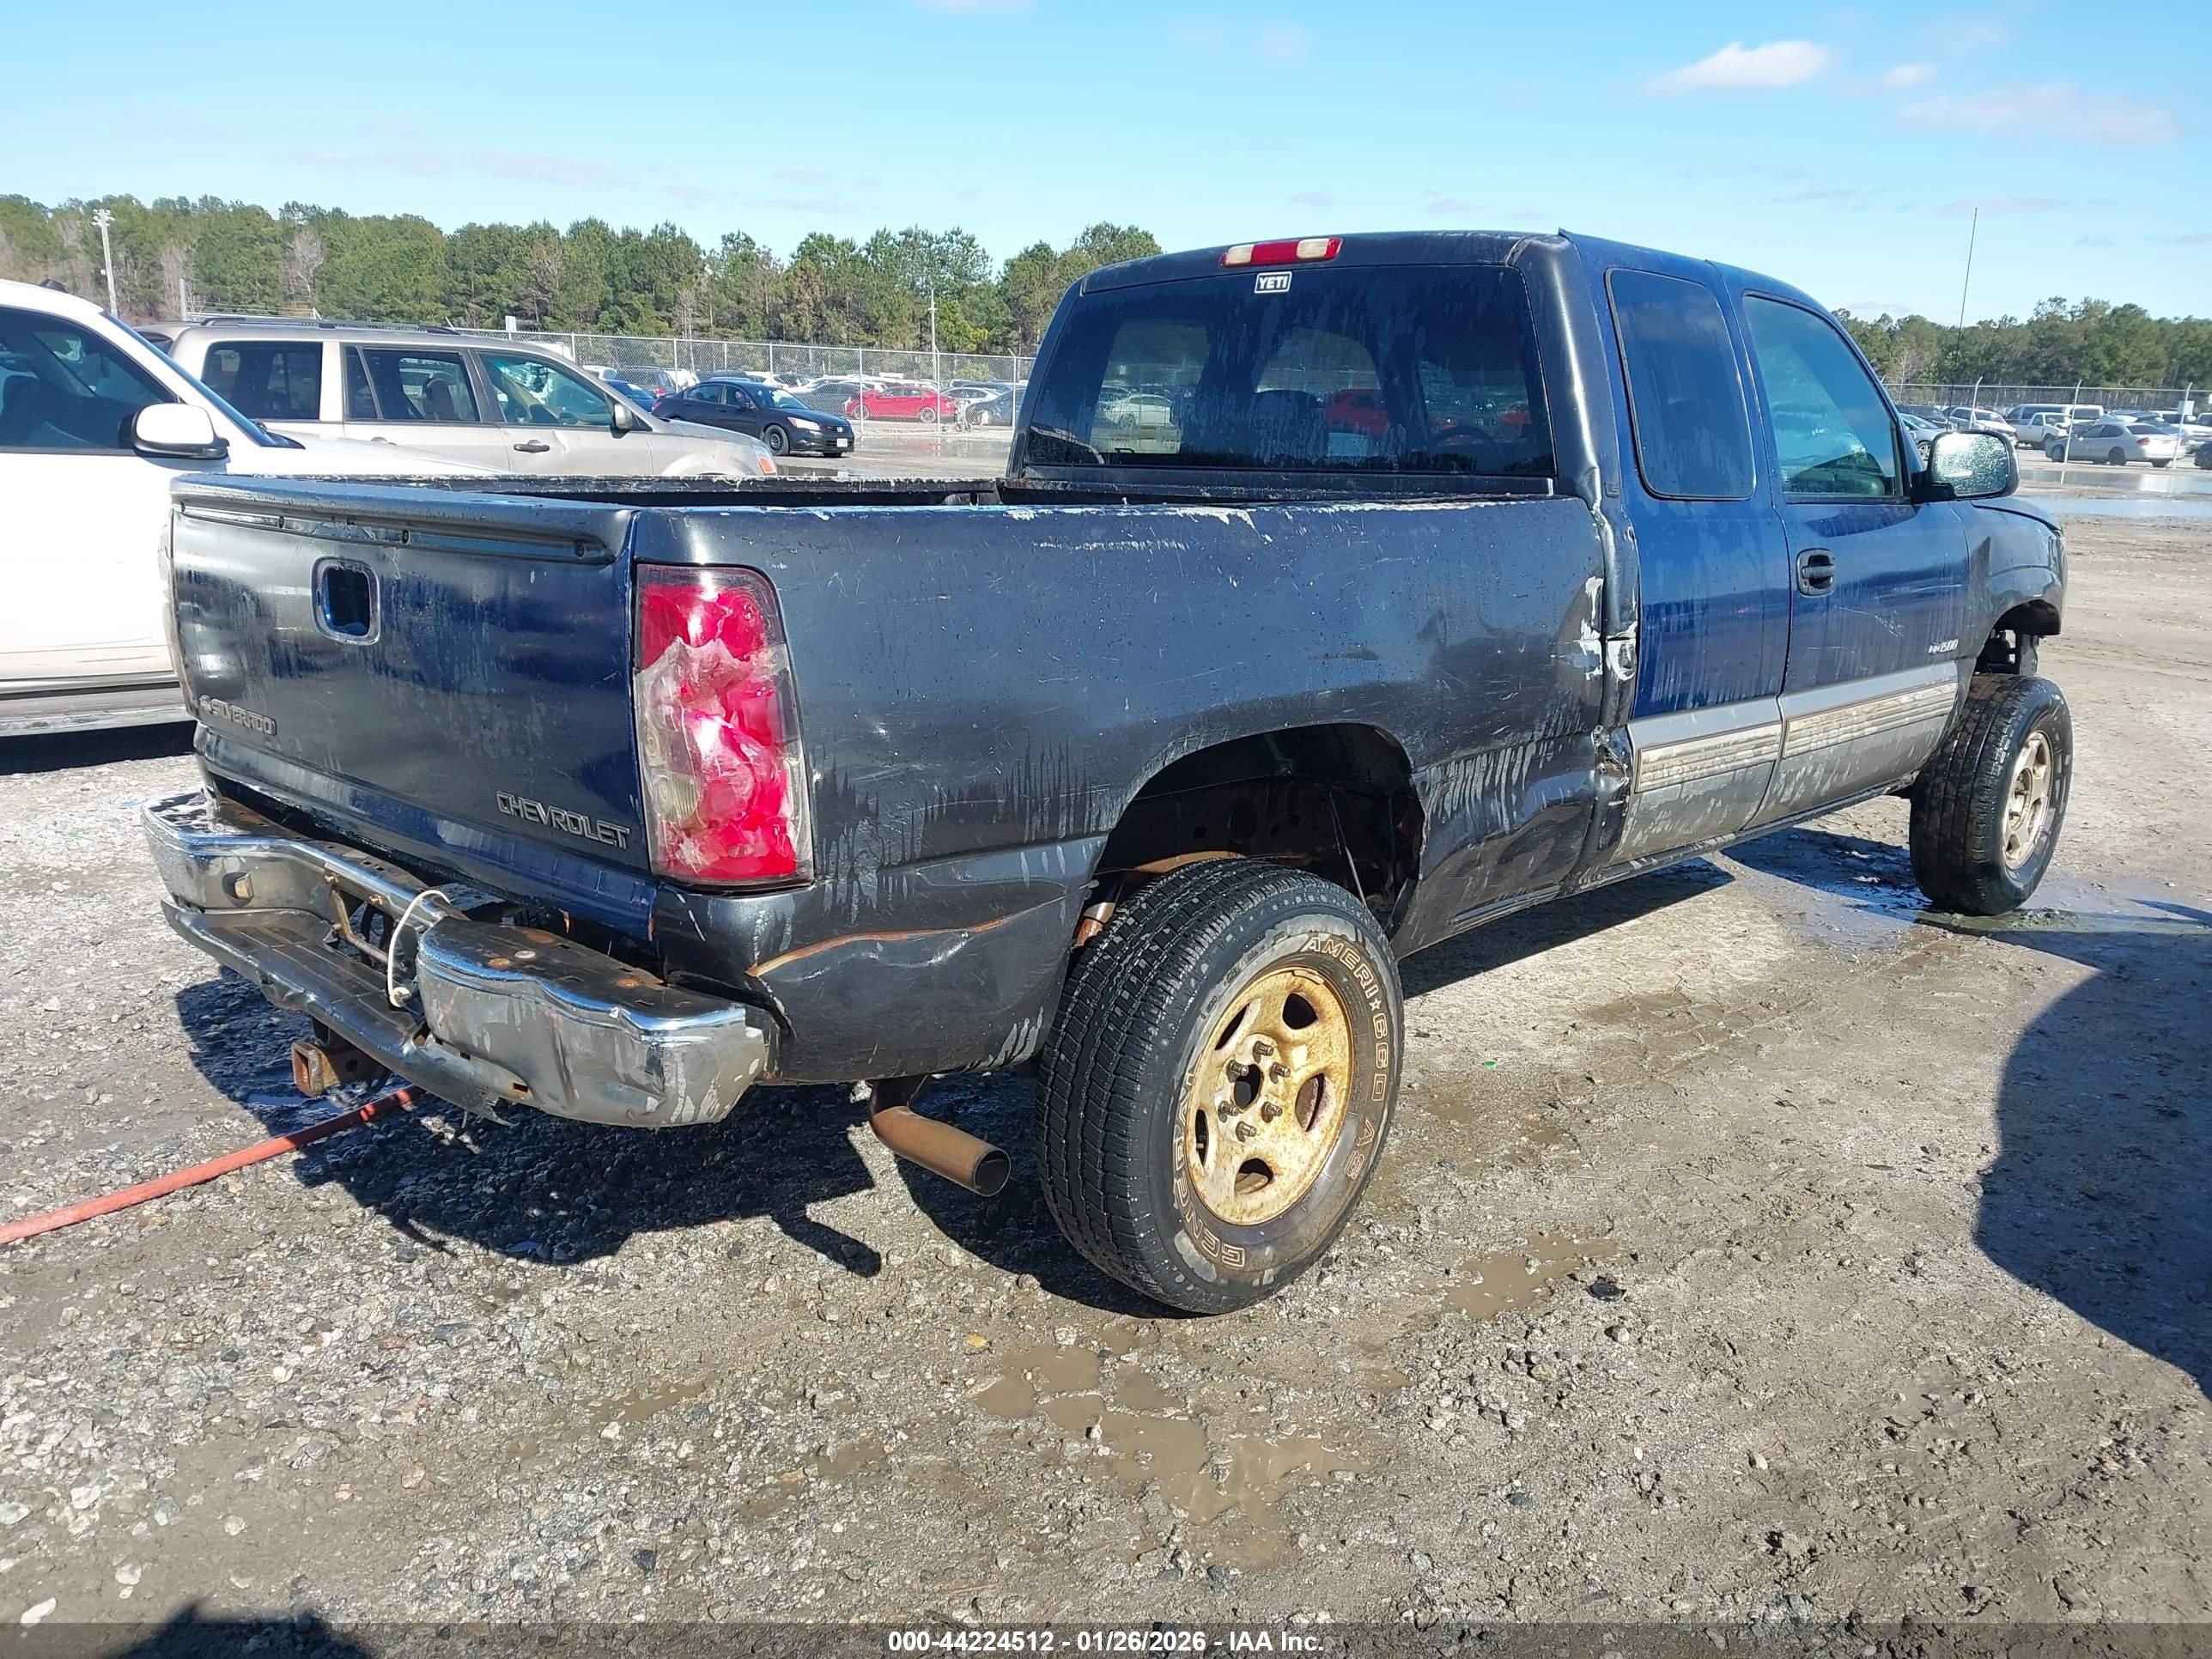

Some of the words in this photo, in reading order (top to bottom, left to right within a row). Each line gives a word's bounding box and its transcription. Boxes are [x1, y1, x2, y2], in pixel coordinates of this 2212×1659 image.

[1259, 276, 1288, 289] YETI
[211, 698, 276, 735] SILVERADO
[496, 790, 630, 850] CHEVROLET
